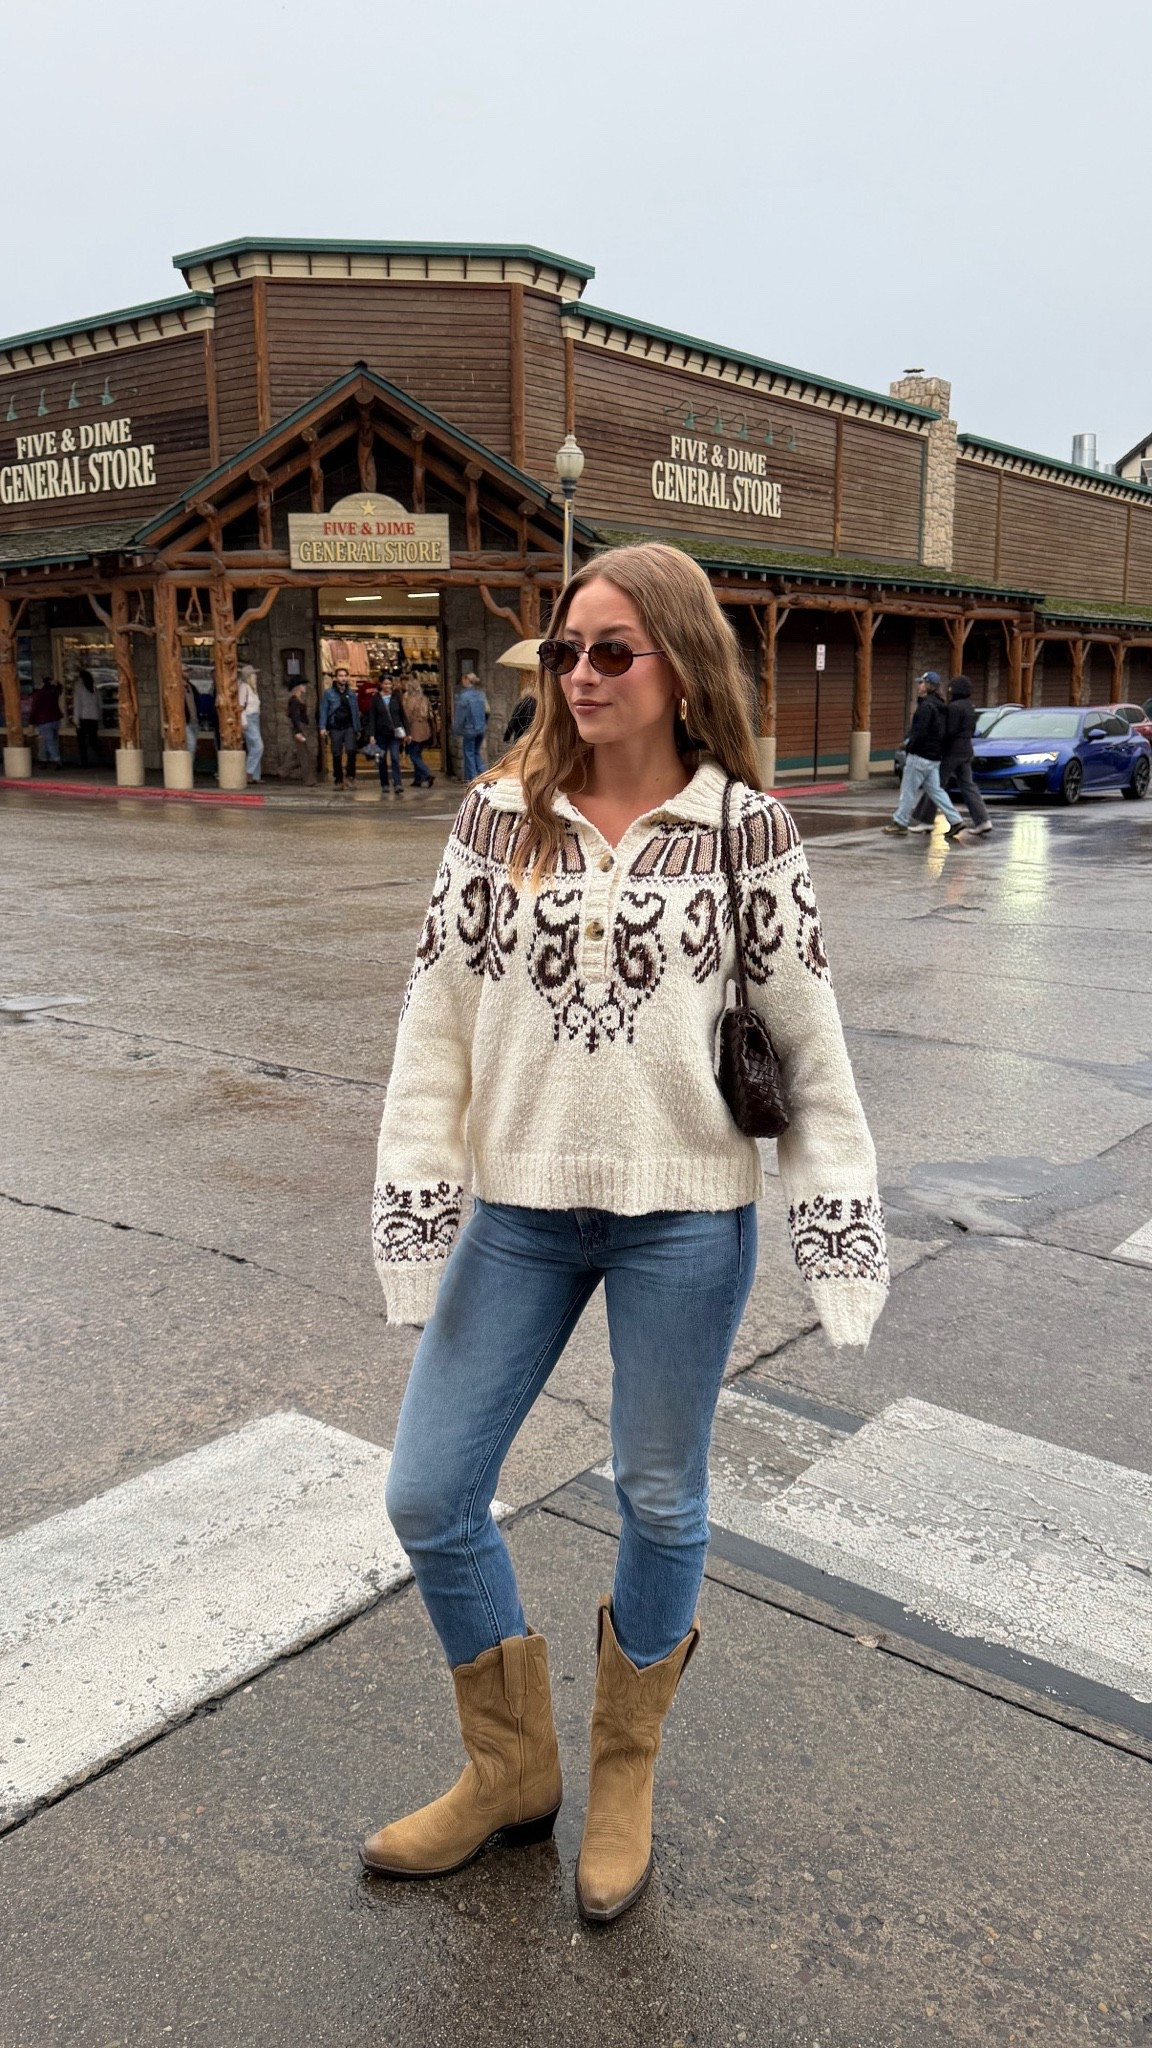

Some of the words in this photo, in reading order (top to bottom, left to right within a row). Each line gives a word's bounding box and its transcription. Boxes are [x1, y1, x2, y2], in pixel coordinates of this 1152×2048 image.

[16, 431, 57, 459] FIVE
[60, 428, 76, 452] &
[79, 417, 132, 449] DIME
[670, 435, 708, 464] FIVE
[711, 444, 724, 468] &
[727, 447, 767, 476] DIME
[0, 456, 86, 504] GENERAL
[88, 444, 157, 492] STORE
[652, 460, 729, 510] GENERAL
[732, 475, 782, 518] STORE
[323, 522, 357, 535] FIVE
[360, 522, 373, 535] &
[376, 522, 416, 535] DIME
[299, 541, 381, 562] GENERAL
[384, 541, 442, 562] STORE
